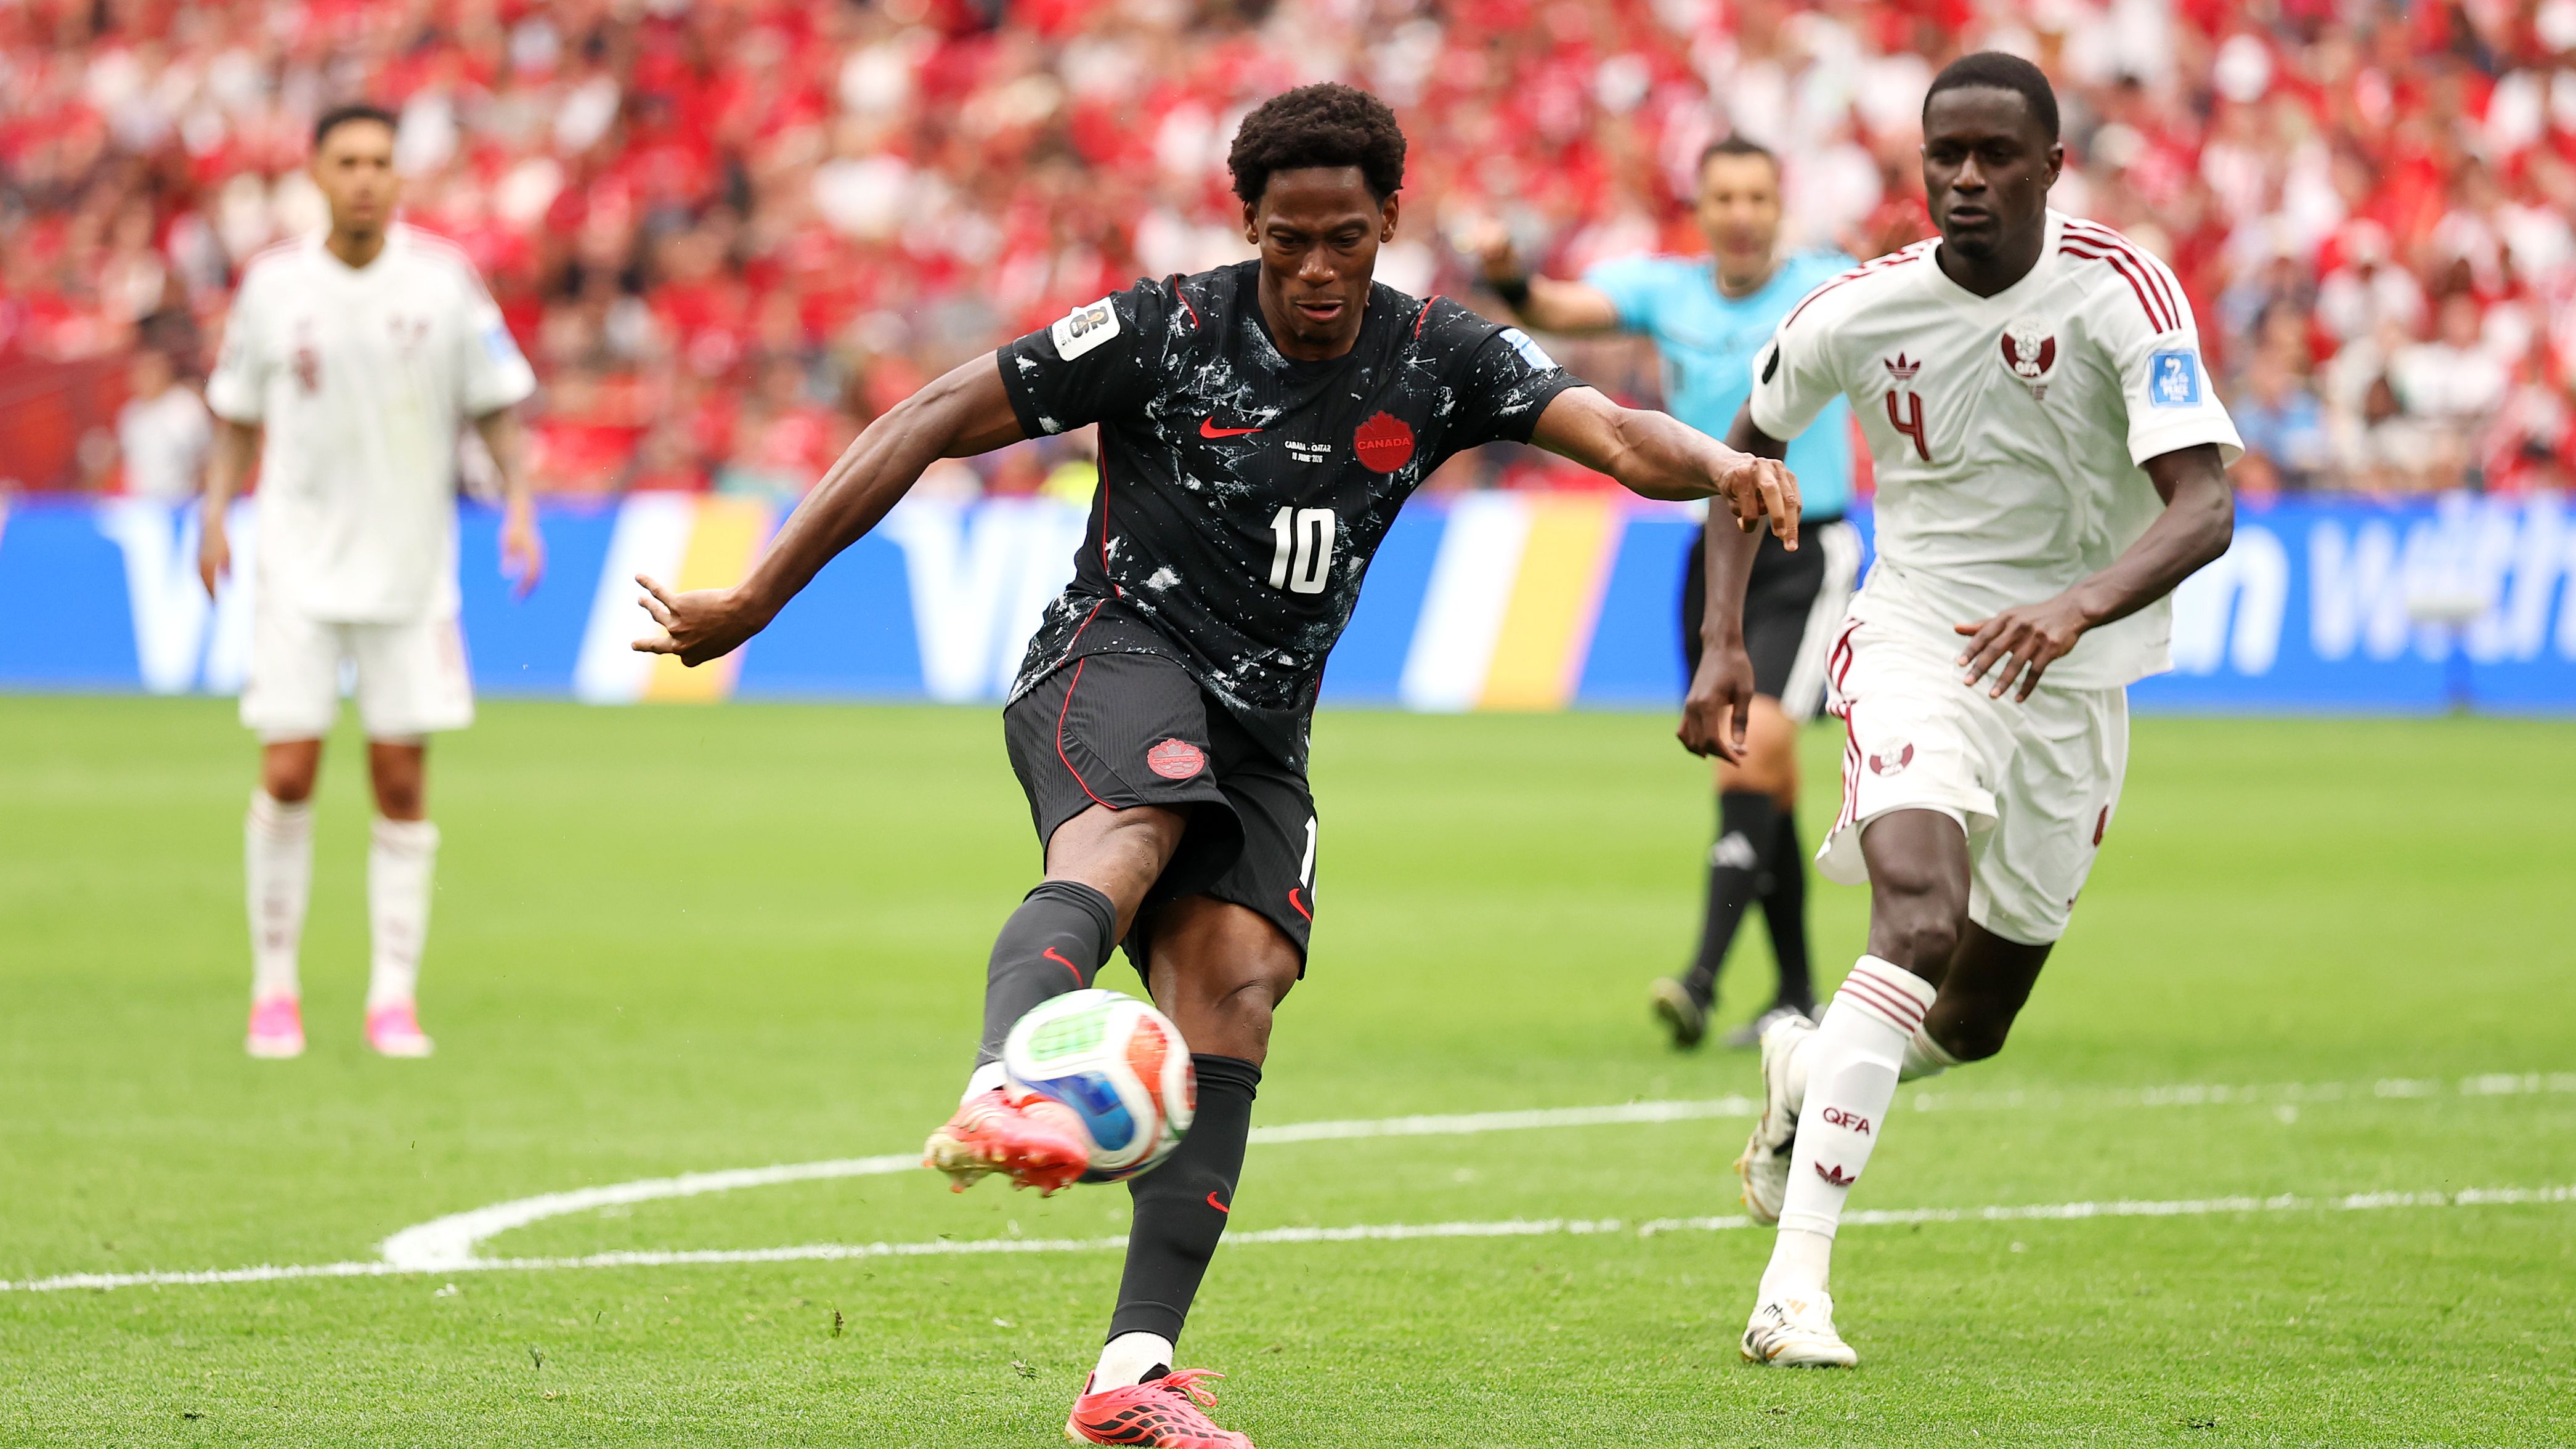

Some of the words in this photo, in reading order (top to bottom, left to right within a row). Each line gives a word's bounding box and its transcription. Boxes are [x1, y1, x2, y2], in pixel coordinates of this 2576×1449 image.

[1887, 390, 1932, 461] 4
[1285, 440, 1306, 452] CANADA
[1311, 444, 1331, 453] QATAR
[1357, 437, 1411, 450] CANADA
[1298, 453, 1311, 463] JUNE
[1268, 506, 1336, 595] 10
[1823, 1107, 1870, 1136] QFA
